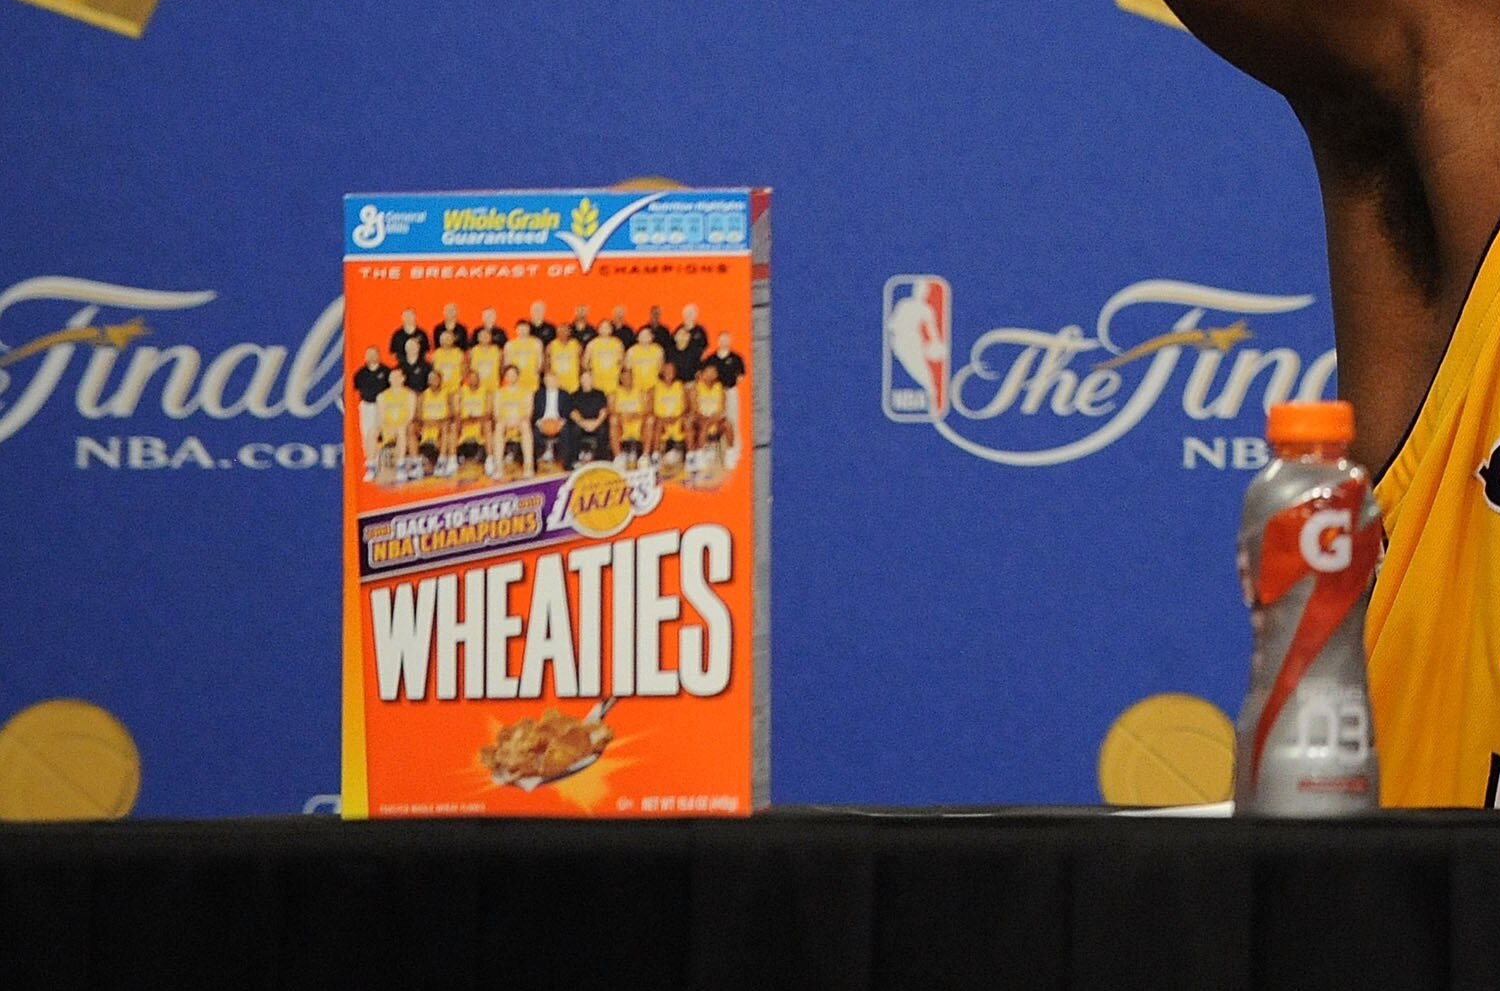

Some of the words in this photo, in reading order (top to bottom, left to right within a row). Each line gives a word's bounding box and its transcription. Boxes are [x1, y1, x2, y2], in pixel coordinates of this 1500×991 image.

[441, 228, 550, 246] Guaranteed
[443, 208, 506, 233] Whole
[507, 208, 561, 231] Grain
[359, 266, 401, 280] THE
[410, 264, 540, 280] BREAKFAST
[546, 264, 578, 279] OF
[599, 264, 729, 276] CHAMPIONS
[0, 275, 344, 442] Final
[951, 325, 1122, 420] The
[373, 536, 417, 564] NBA
[420, 511, 538, 554] CHAMPIONS
[393, 499, 518, 541] BACK-TO-BACK
[1300, 509, 1354, 573] G
[369, 523, 733, 702] WHEATIES
